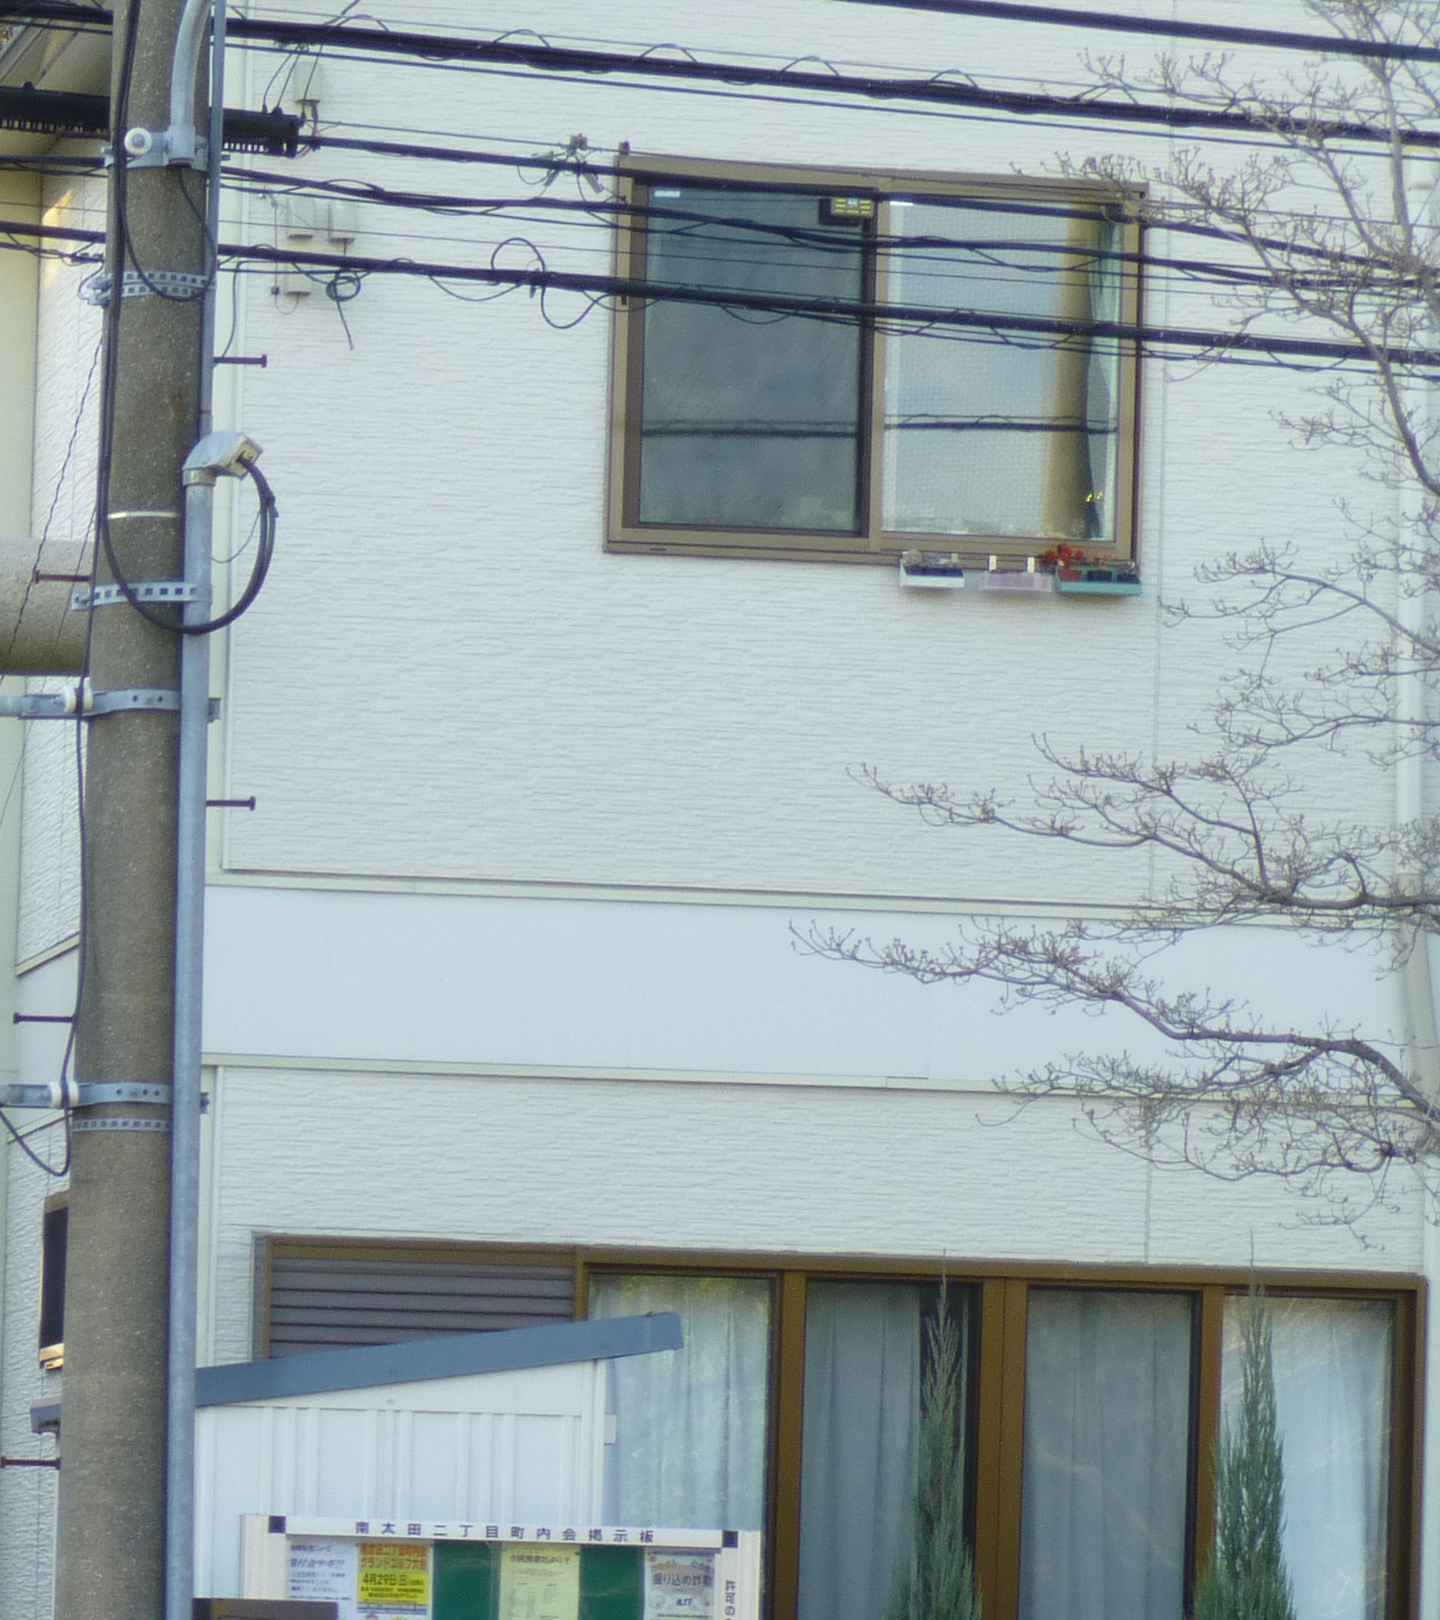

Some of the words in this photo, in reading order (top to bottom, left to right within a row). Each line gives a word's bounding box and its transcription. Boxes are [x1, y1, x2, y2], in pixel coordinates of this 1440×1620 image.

[355, 1521, 654, 1544] 南太田二丁目町内会掲示板
